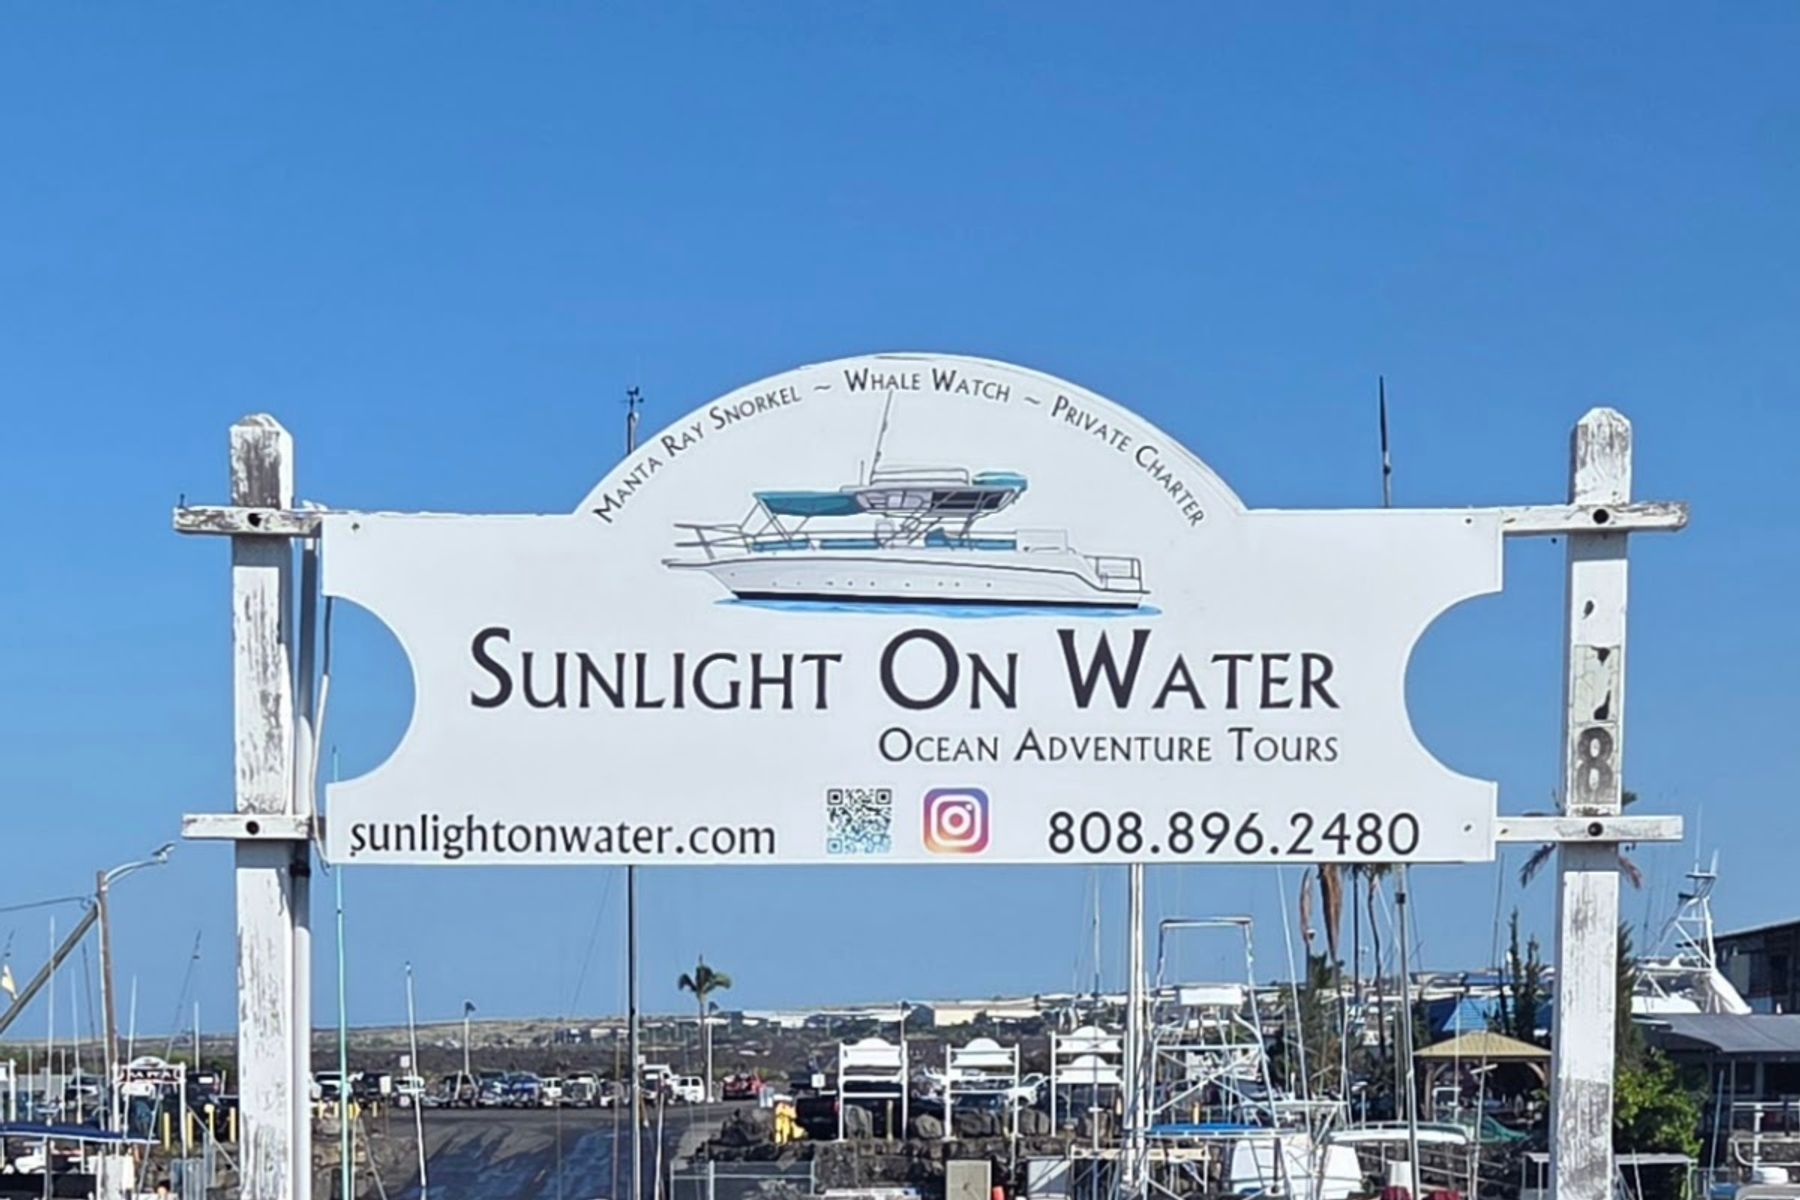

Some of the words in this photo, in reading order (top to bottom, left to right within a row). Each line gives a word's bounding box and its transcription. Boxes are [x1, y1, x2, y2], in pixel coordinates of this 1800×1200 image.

[592, 456, 663, 523] MANTA
[661, 421, 705, 457] RAY
[709, 385, 803, 430] SNORKEL
[844, 367, 921, 392] WHALE
[932, 367, 1010, 402] WATCH
[1051, 394, 1132, 453] PRIVATE
[1135, 445, 1205, 527] CHARTER
[470, 626, 844, 710] SUNLIGHT
[879, 628, 1018, 711] ON
[1056, 628, 1341, 710] WATER
[878, 727, 998, 762] OCEAN
[1014, 727, 1212, 762] ADVENTURE
[1227, 727, 1339, 762] TOURS
[350, 813, 776, 860] sunlightonwater.com
[1048, 811, 1421, 856] 808.896.2480
